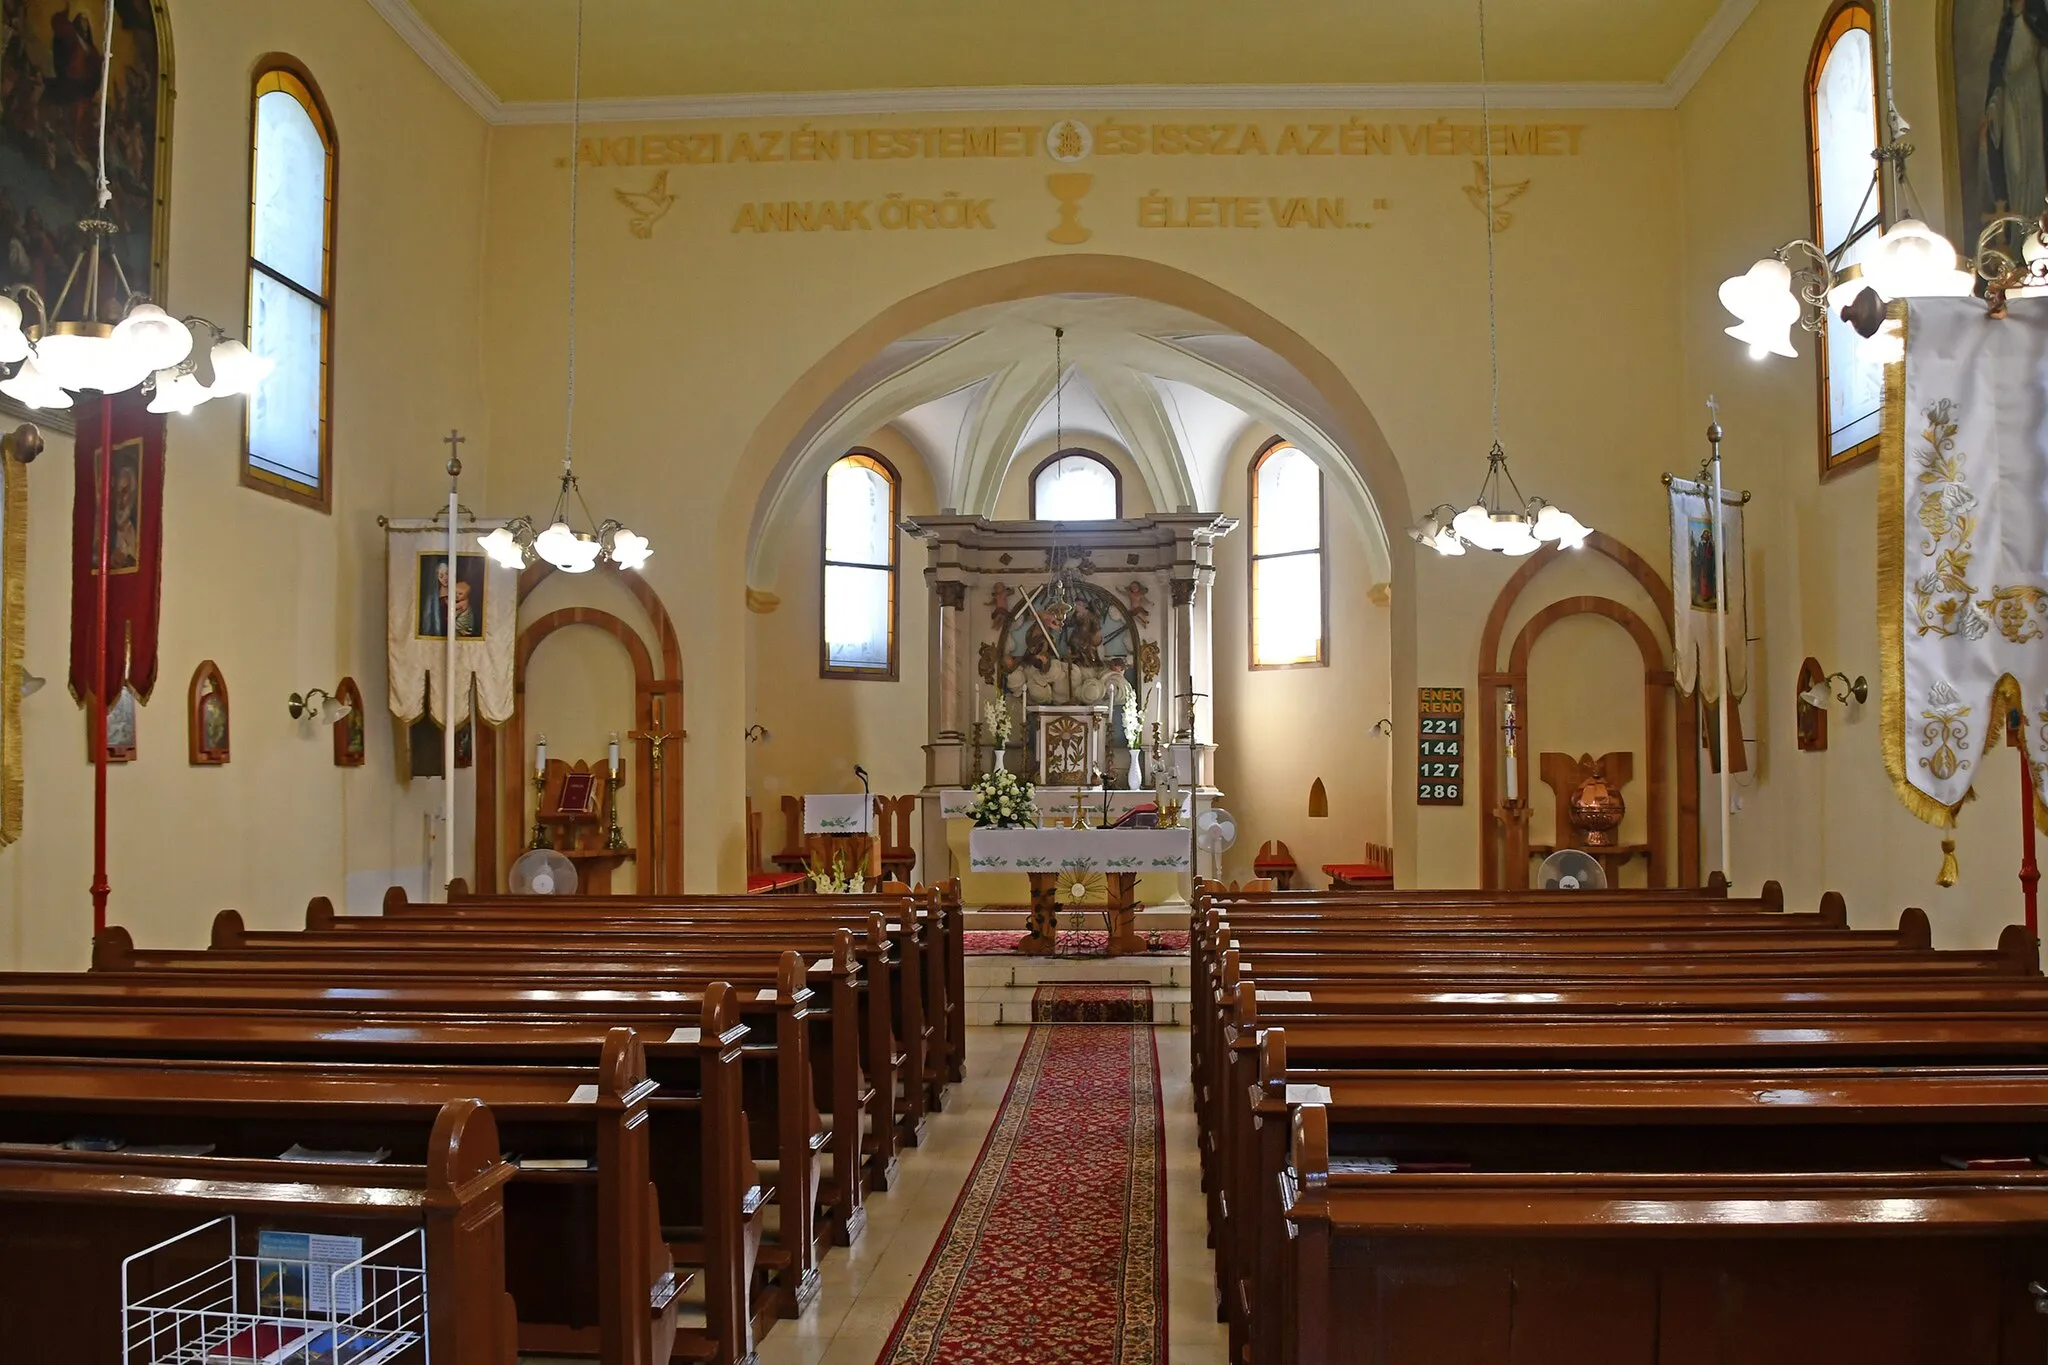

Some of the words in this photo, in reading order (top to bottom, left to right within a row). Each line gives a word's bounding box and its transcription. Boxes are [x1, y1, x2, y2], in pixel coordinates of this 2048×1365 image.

[641, 133, 722, 166] ESZI
[728, 130, 784, 164] AZ
[789, 121, 840, 161] ÉN
[846, 126, 1043, 160] TESTEMET
[1093, 116, 1146, 155] ÉS
[1152, 122, 1269, 155] ISSZA
[1276, 123, 1335, 156] AZ
[1340, 115, 1391, 155] ÉN
[1397, 115, 1588, 156] VÉREMET
[731, 200, 872, 233] ANNAK
[1138, 188, 1262, 228] ÉLETE
[1421, 702, 1462, 713] REND
[1422, 720, 1457, 734] 221
[1421, 741, 1458, 755] 144
[1421, 763, 1459, 777] 127
[1420, 784, 1458, 798] 286
